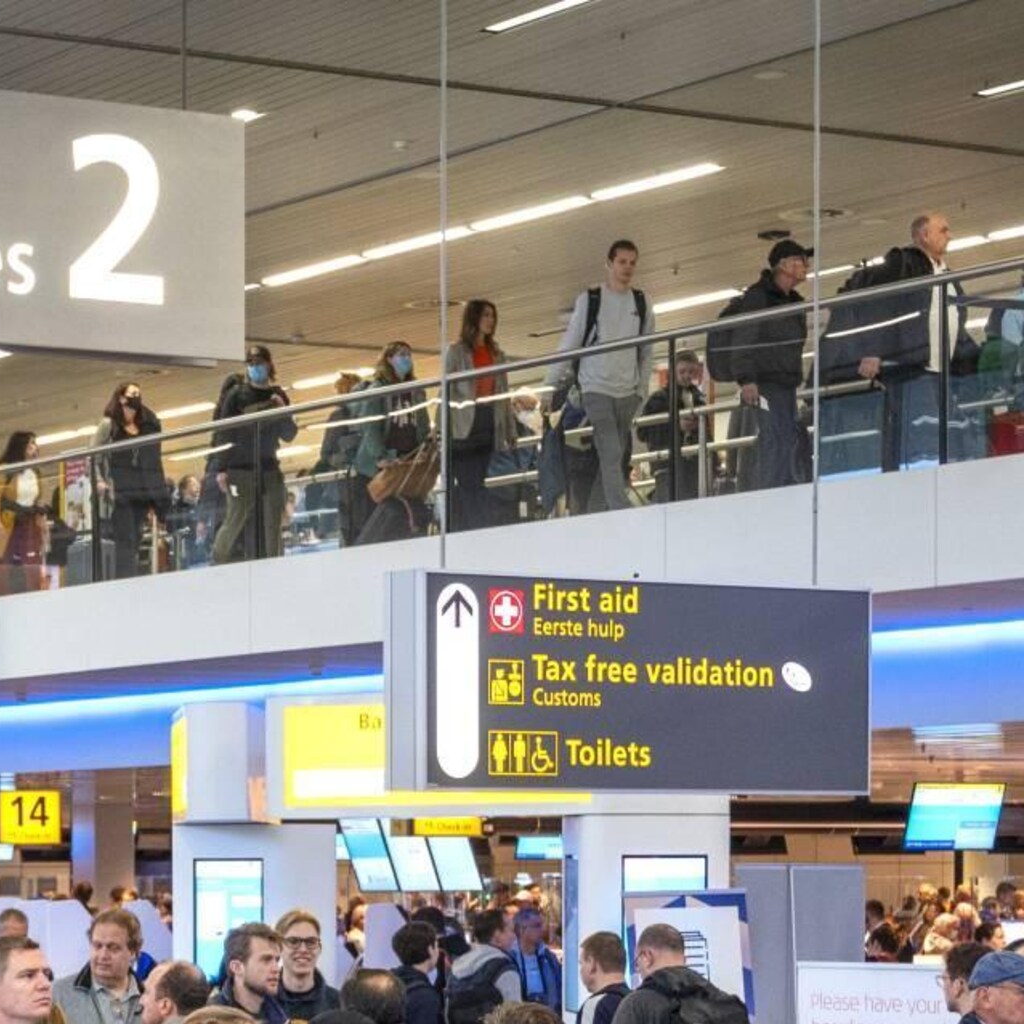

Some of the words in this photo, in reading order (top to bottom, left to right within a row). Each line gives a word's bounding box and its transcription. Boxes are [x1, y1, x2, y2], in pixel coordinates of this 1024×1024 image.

[68, 133, 165, 306] 2
[534, 583, 591, 612] First
[599, 586, 638, 613] aid
[534, 617, 583, 636] Eerste
[588, 618, 624, 642] hulp
[532, 654, 576, 681] Tax
[585, 654, 637, 683] free
[646, 656, 774, 687] validation
[533, 687, 602, 708] Customs
[565, 738, 652, 767] Toilets
[11, 796, 50, 828] 14
[811, 990, 860, 1012] Please
[864, 991, 903, 1013] have
[906, 997, 942, 1016] your
